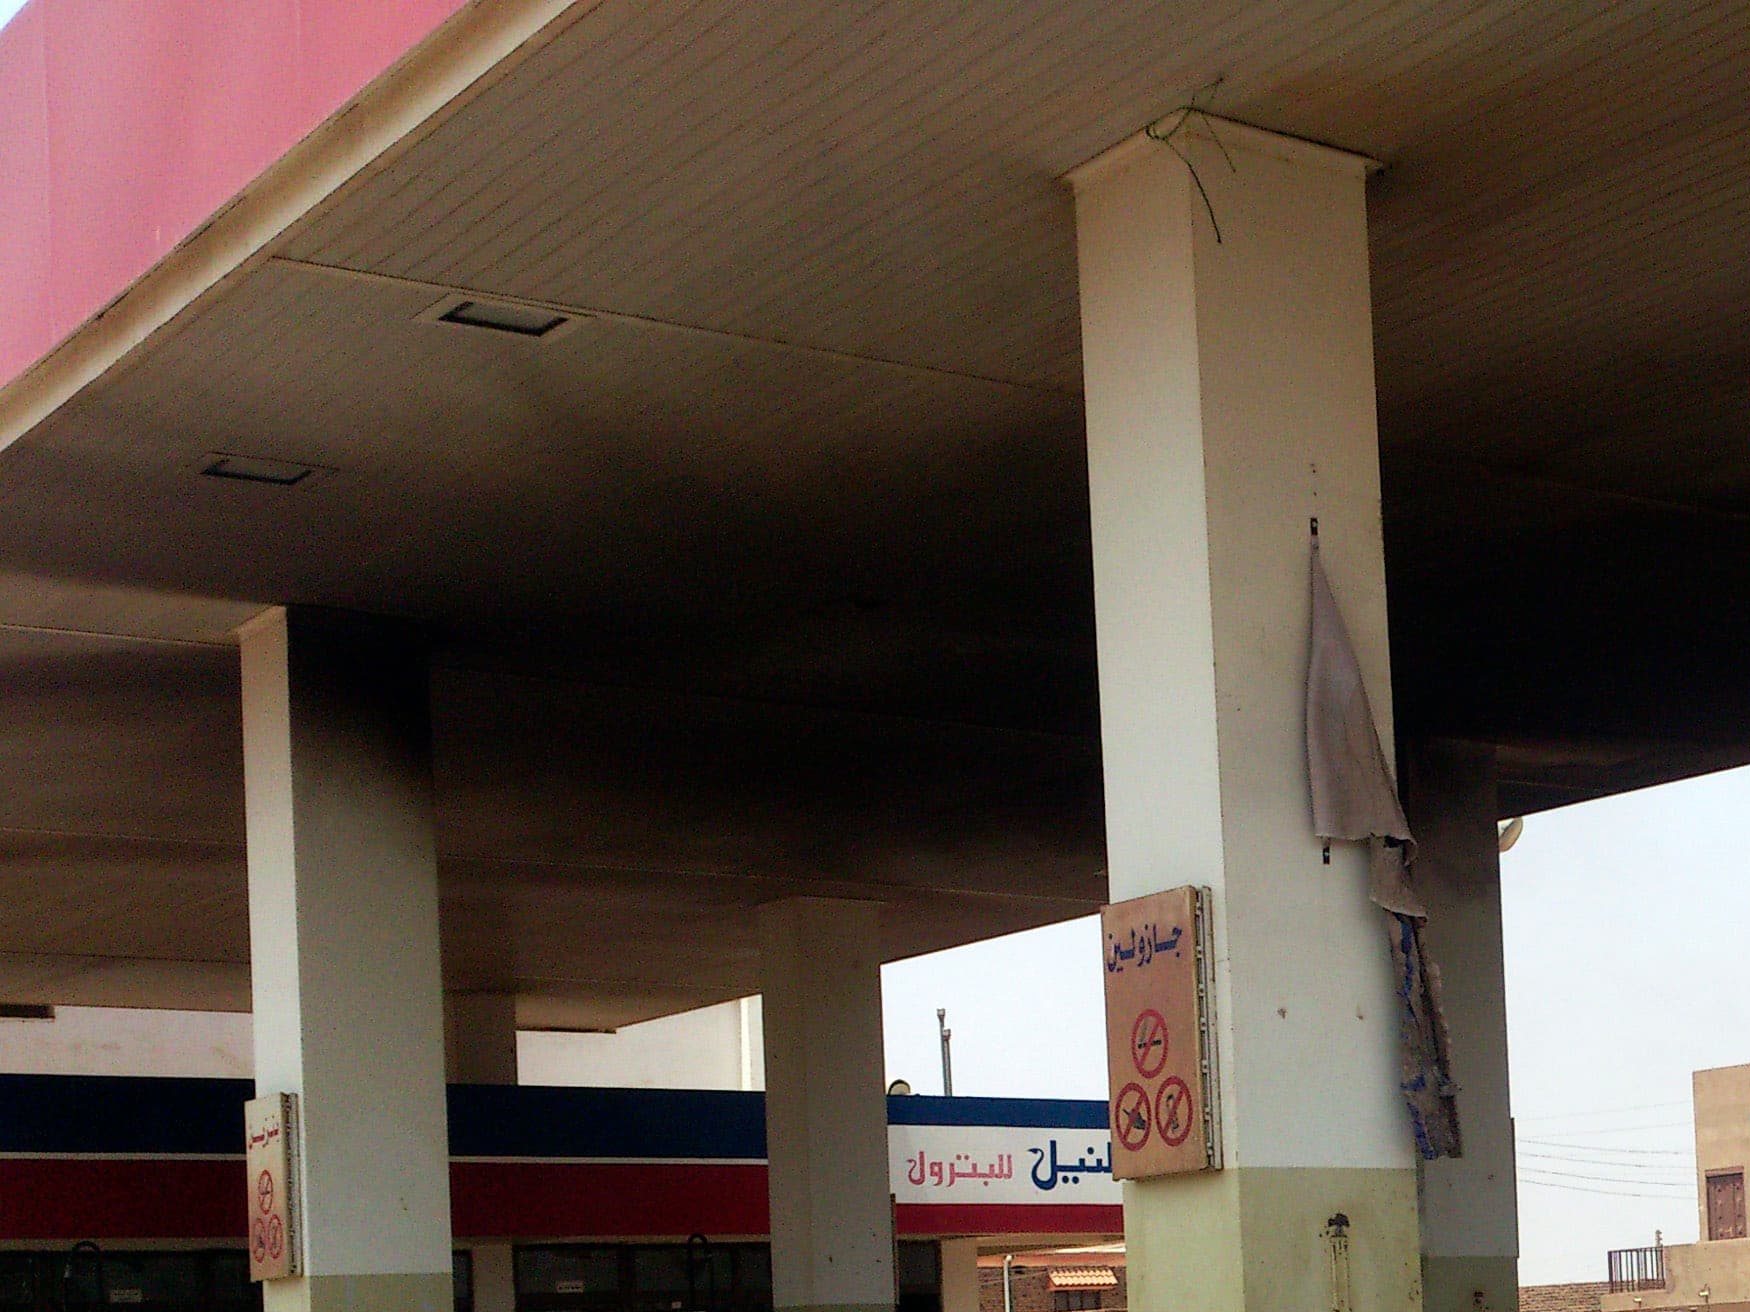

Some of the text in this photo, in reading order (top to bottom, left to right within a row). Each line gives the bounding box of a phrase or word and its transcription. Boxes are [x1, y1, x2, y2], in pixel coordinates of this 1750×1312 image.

[1107, 924, 1182, 972] جازولين
[905, 1139, 1113, 1191] لنيل للبترول
